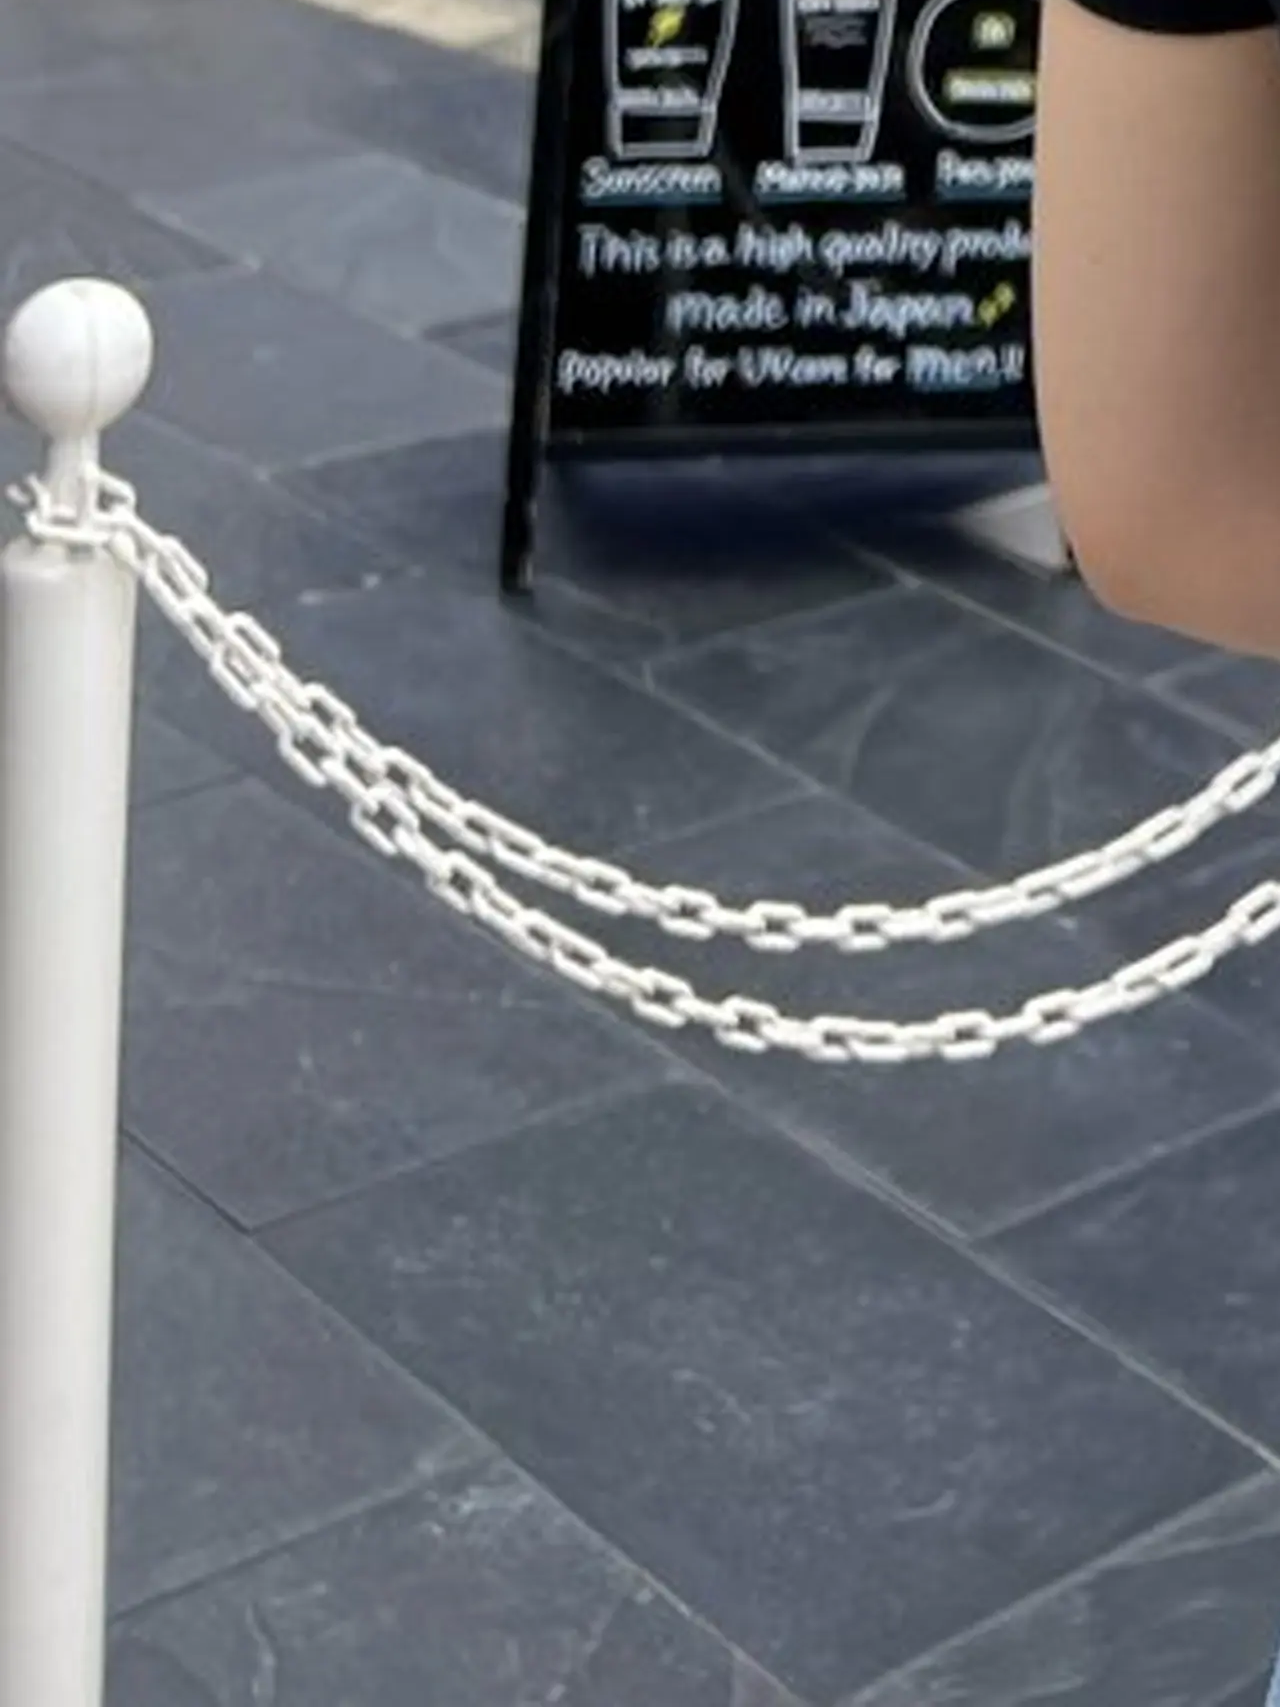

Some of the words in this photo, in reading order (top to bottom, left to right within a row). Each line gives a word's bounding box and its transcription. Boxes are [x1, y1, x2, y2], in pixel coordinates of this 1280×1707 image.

[577, 223, 660, 277] This
[735, 222, 814, 273] high
[819, 221, 940, 279] quality
[666, 287, 789, 334] made
[795, 285, 835, 329] in
[842, 280, 974, 339] Japan
